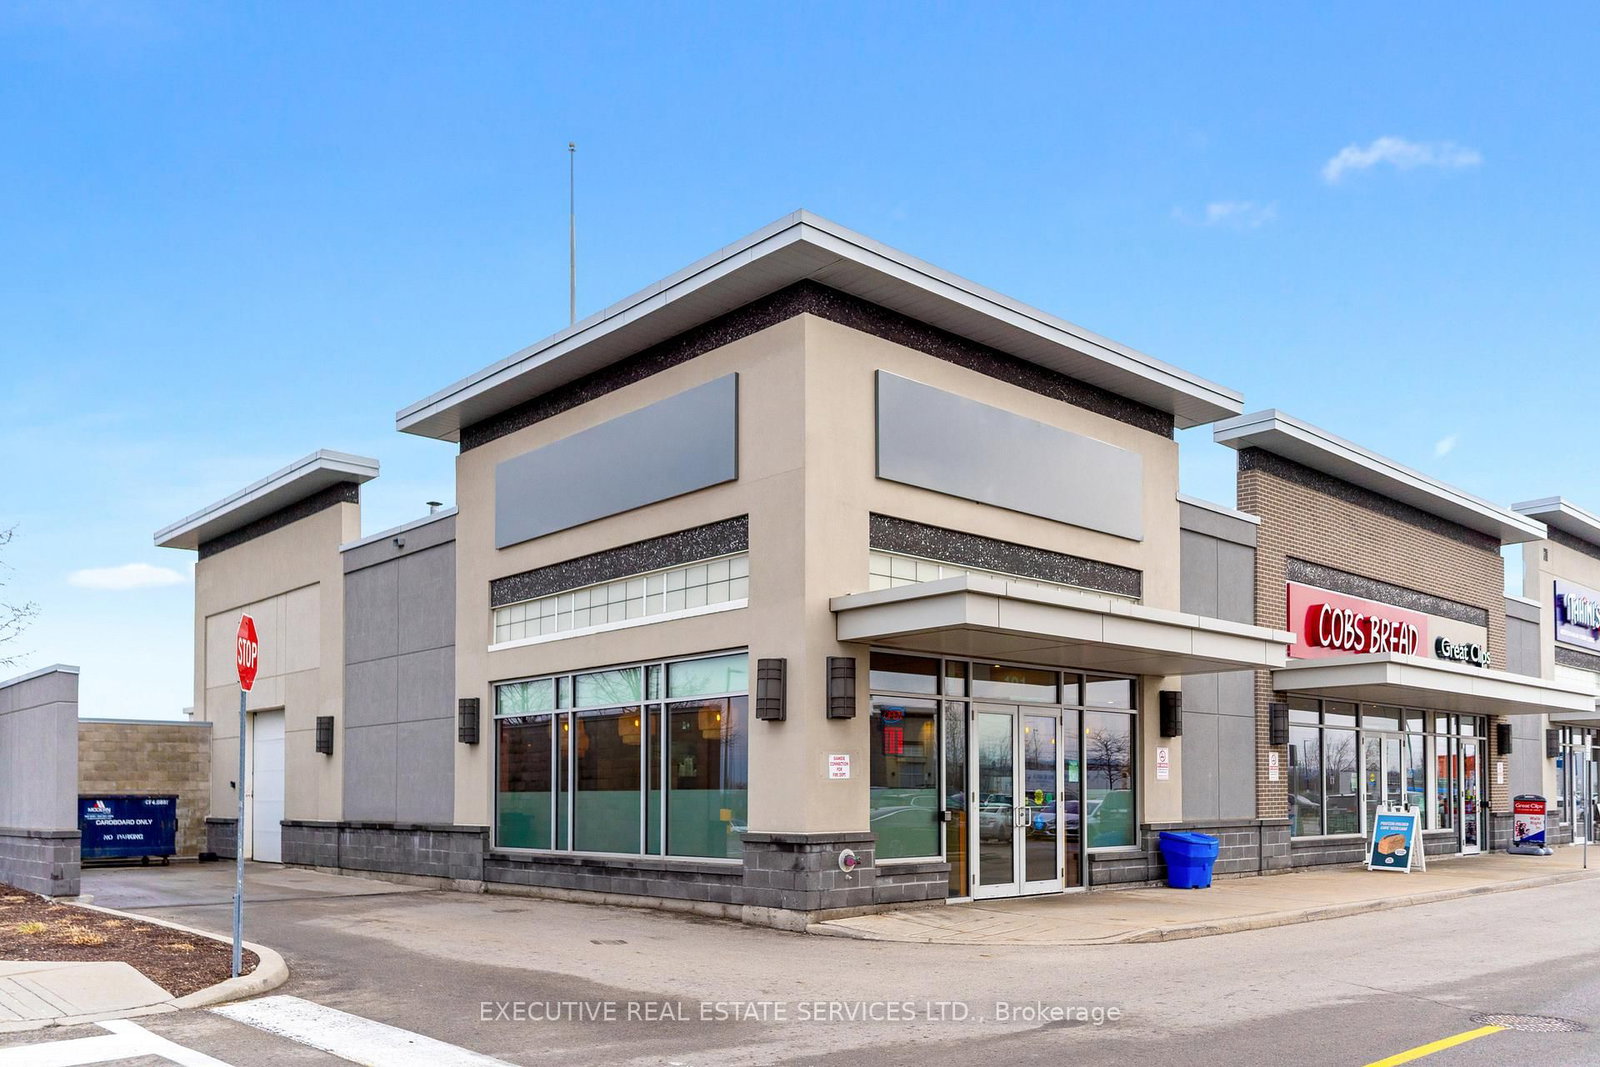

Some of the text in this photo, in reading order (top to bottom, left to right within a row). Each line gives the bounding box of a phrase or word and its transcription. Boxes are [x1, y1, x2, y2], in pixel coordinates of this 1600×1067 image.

[1319, 602, 1419, 656] COBS BREAD
[237, 636, 257, 668] STOP
[1441, 637, 1469, 660] Great
